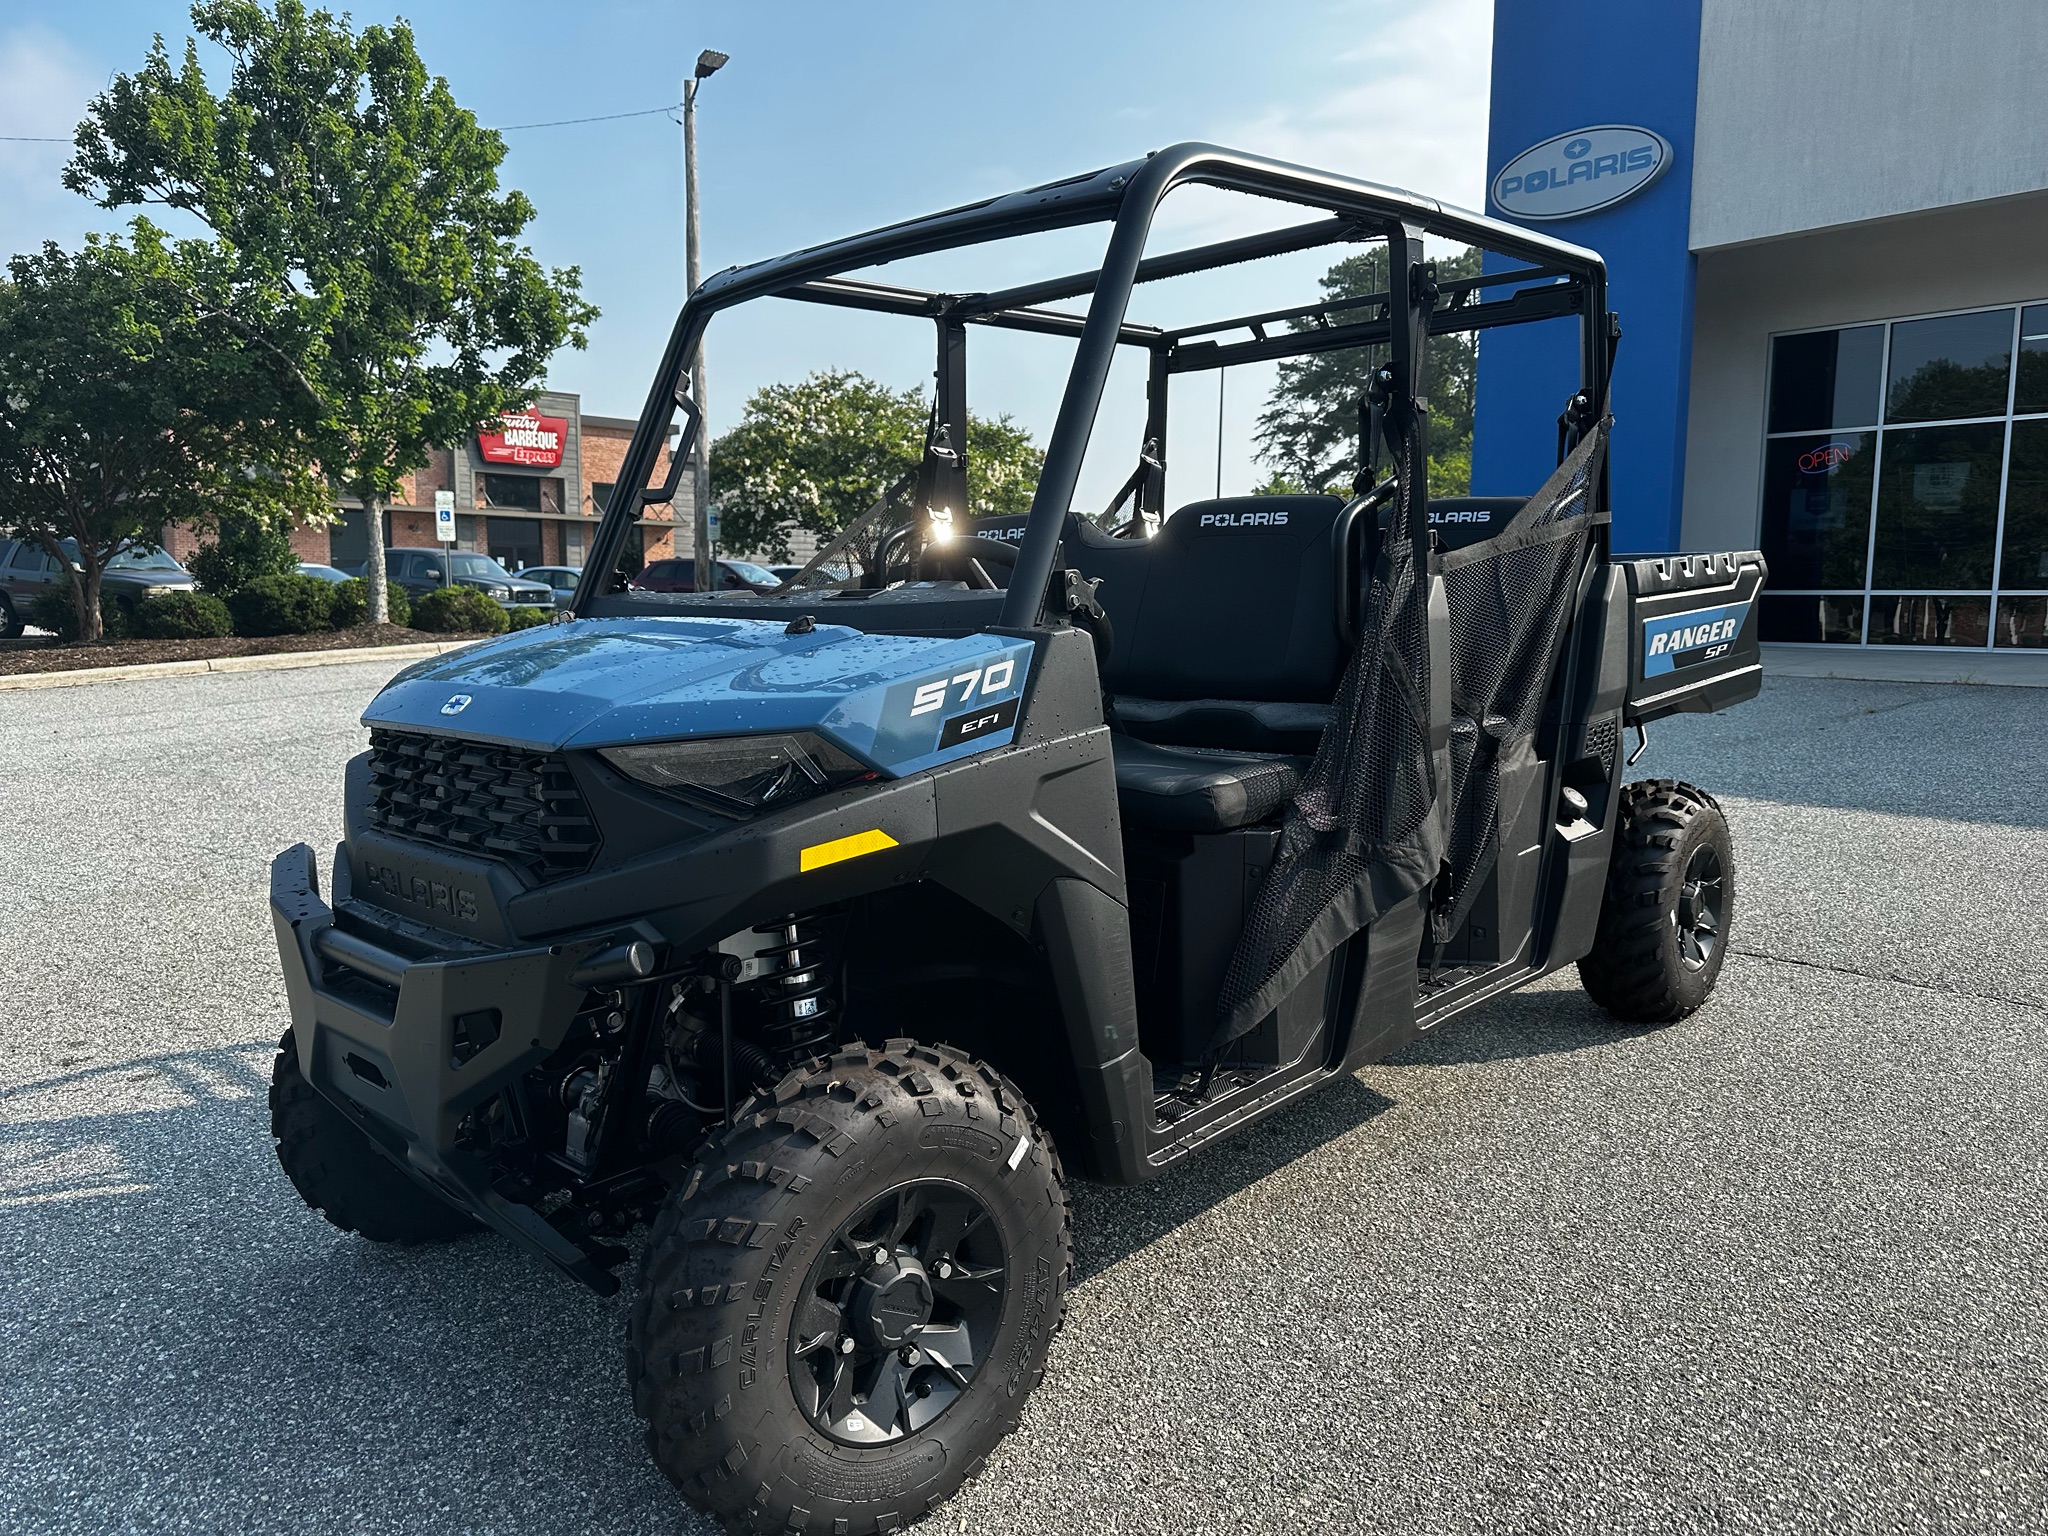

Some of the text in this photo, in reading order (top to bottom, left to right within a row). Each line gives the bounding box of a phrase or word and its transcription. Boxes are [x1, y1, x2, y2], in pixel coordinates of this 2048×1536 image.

[1501, 145, 1653, 200] POLARIS
[504, 428, 558, 450] BARBEQUE
[514, 446, 556, 464] Express
[1798, 446, 1850, 470] OPEN
[1200, 511, 1289, 527] POLARIS
[1649, 618, 1736, 656] RANGER
[1704, 643, 1728, 659] SP
[910, 660, 1014, 717] 570
[961, 713, 999, 734] EFI
[365, 861, 478, 922] POLARIS
[740, 1215, 808, 1390] CARLSTAR
